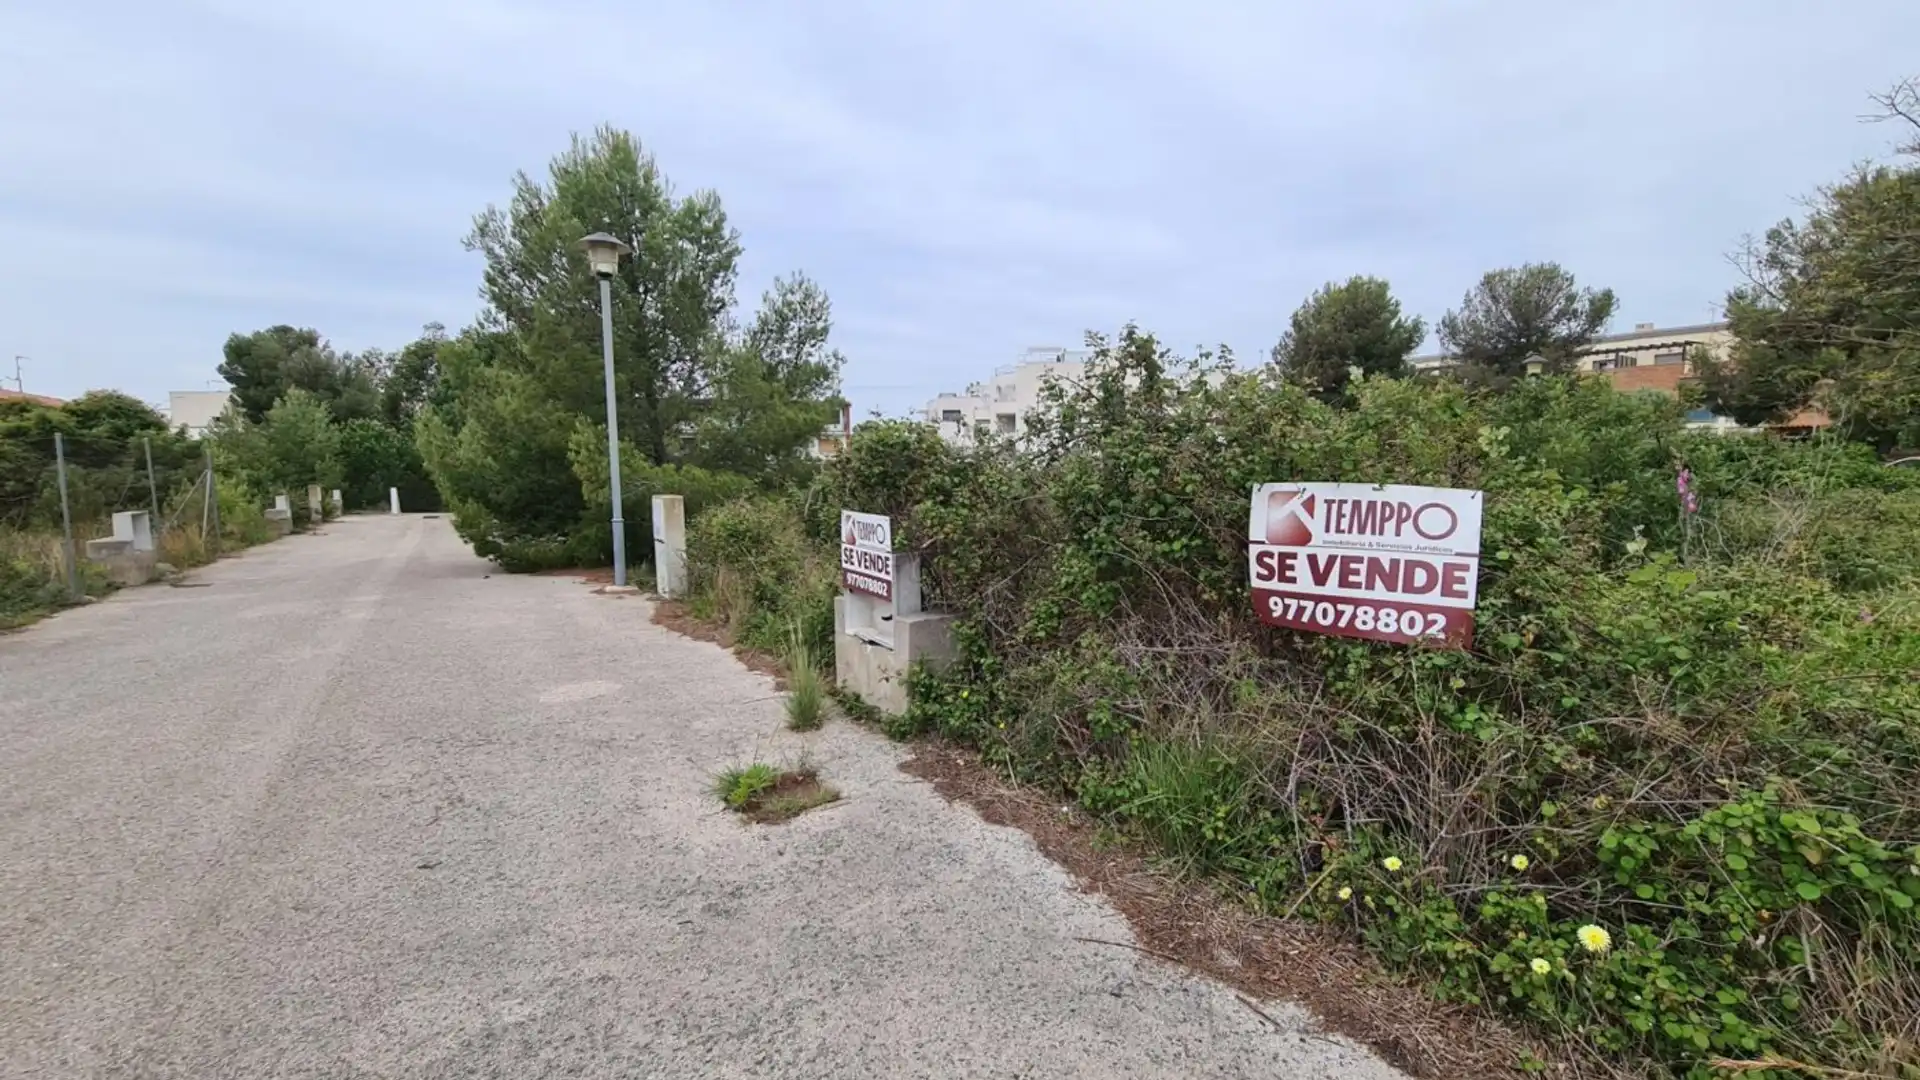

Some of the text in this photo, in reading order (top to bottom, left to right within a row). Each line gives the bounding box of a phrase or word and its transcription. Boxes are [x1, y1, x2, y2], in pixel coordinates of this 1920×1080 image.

[856, 520, 886, 544] TEMPPO
[1323, 498, 1458, 540] TEMPPO
[843, 547, 891, 576] SE VENDE
[1255, 550, 1471, 599] SE VENDE
[846, 572, 888, 597] 977078802
[1268, 596, 1447, 639] 977078802
